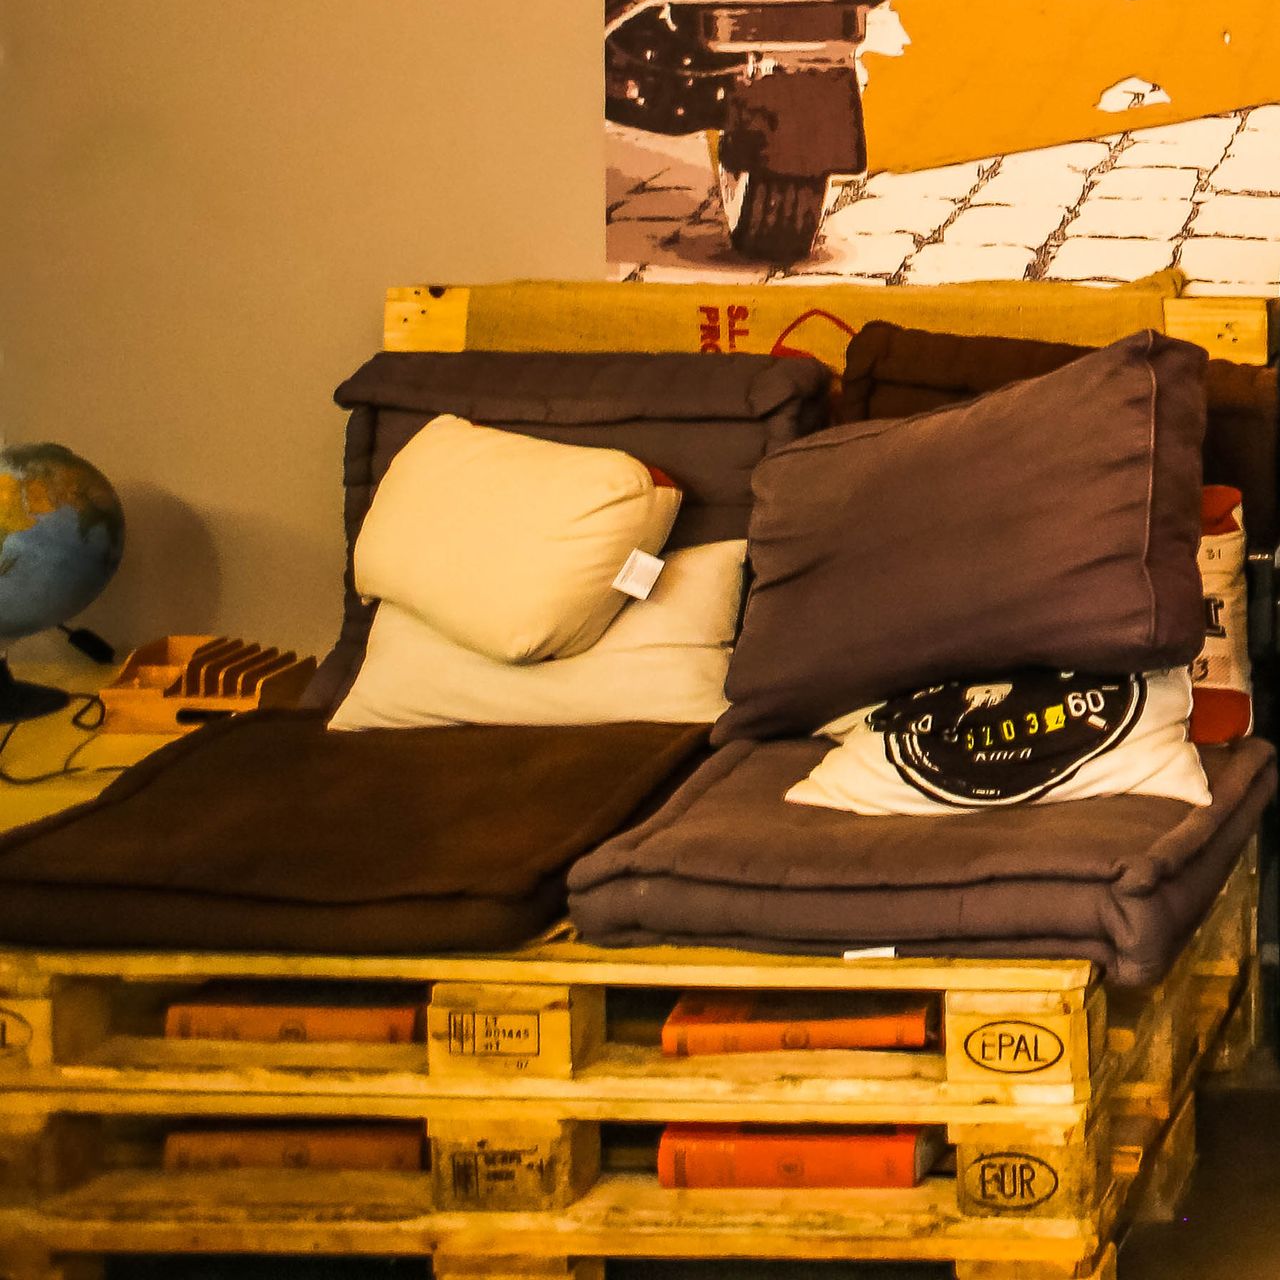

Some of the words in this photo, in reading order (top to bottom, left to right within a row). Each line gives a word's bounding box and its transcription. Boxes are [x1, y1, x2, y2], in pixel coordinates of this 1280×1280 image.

[1067, 690, 1105, 718] 60
[980, 1031, 1048, 1063] EPAL
[979, 1160, 1037, 1202] EUR
